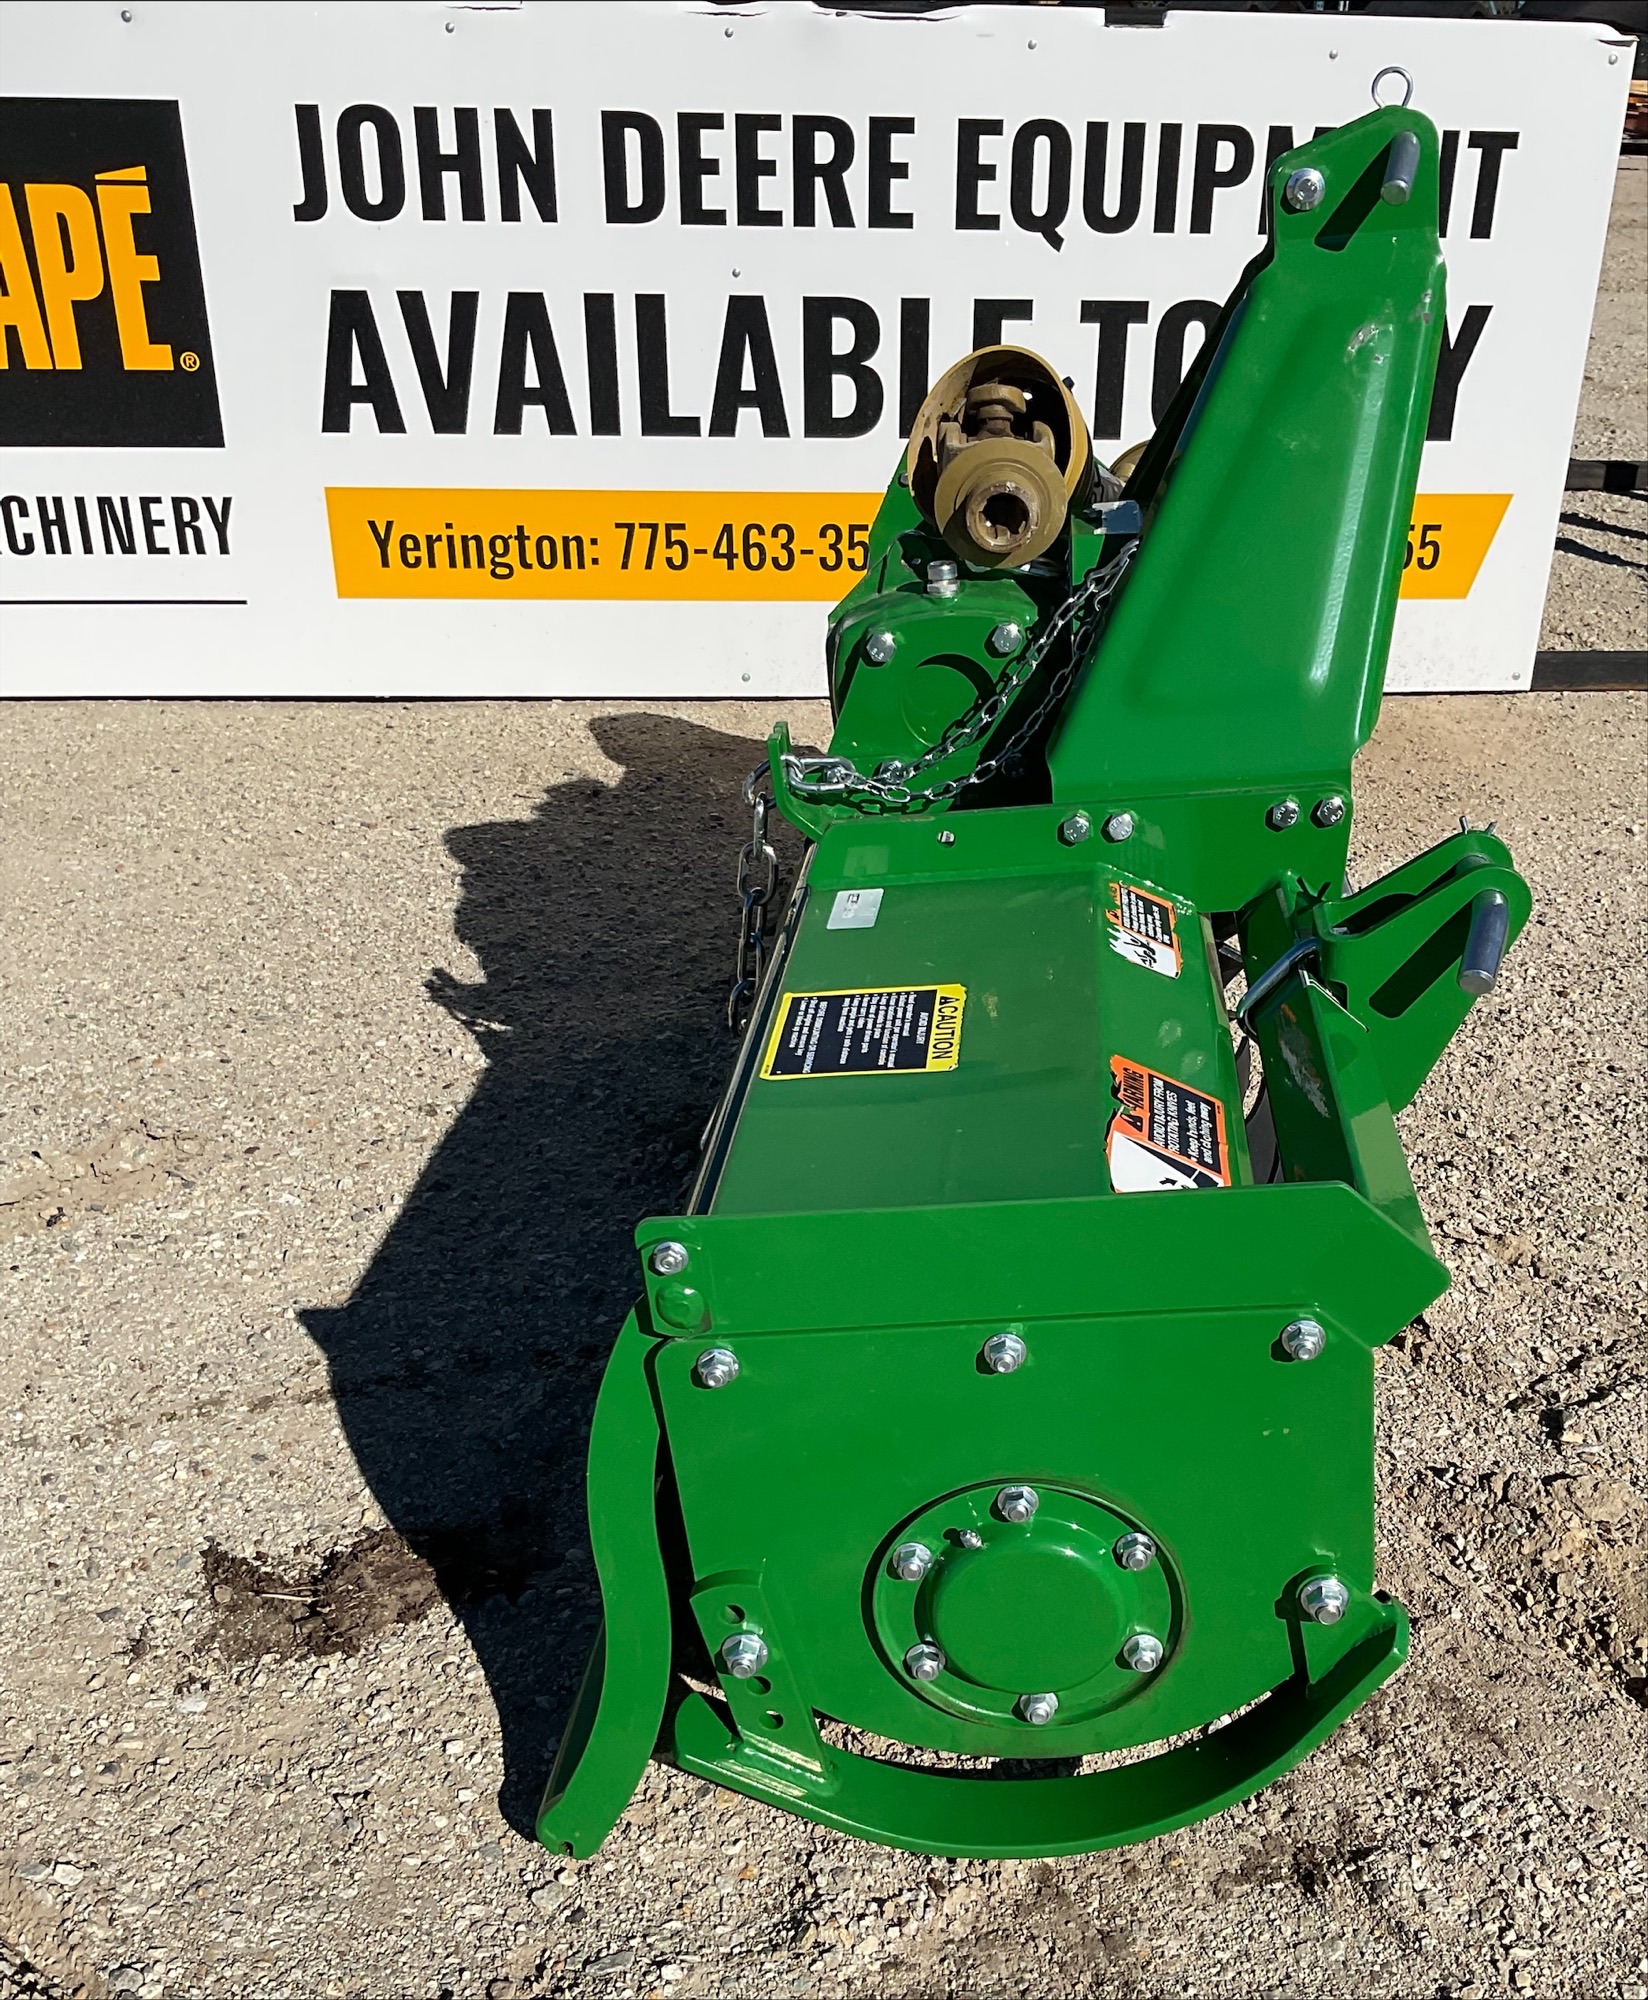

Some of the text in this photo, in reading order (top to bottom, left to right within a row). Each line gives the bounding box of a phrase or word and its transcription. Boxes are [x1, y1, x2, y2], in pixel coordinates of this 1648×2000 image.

[293, 103, 1520, 252] JOHN DEERE EQUIPT
[1080, 299, 1494, 442] TOY
[0, 495, 233, 556] CHINERY
[367, 519, 600, 580] Yerington:
[614, 522, 870, 571] 775-463-35
[933, 1006, 957, 1059] CAUTION
[1153, 1078, 1164, 1099] FROM
[1154, 1123, 1165, 1147] AVOID
[1188, 1138, 1200, 1157] Keep
